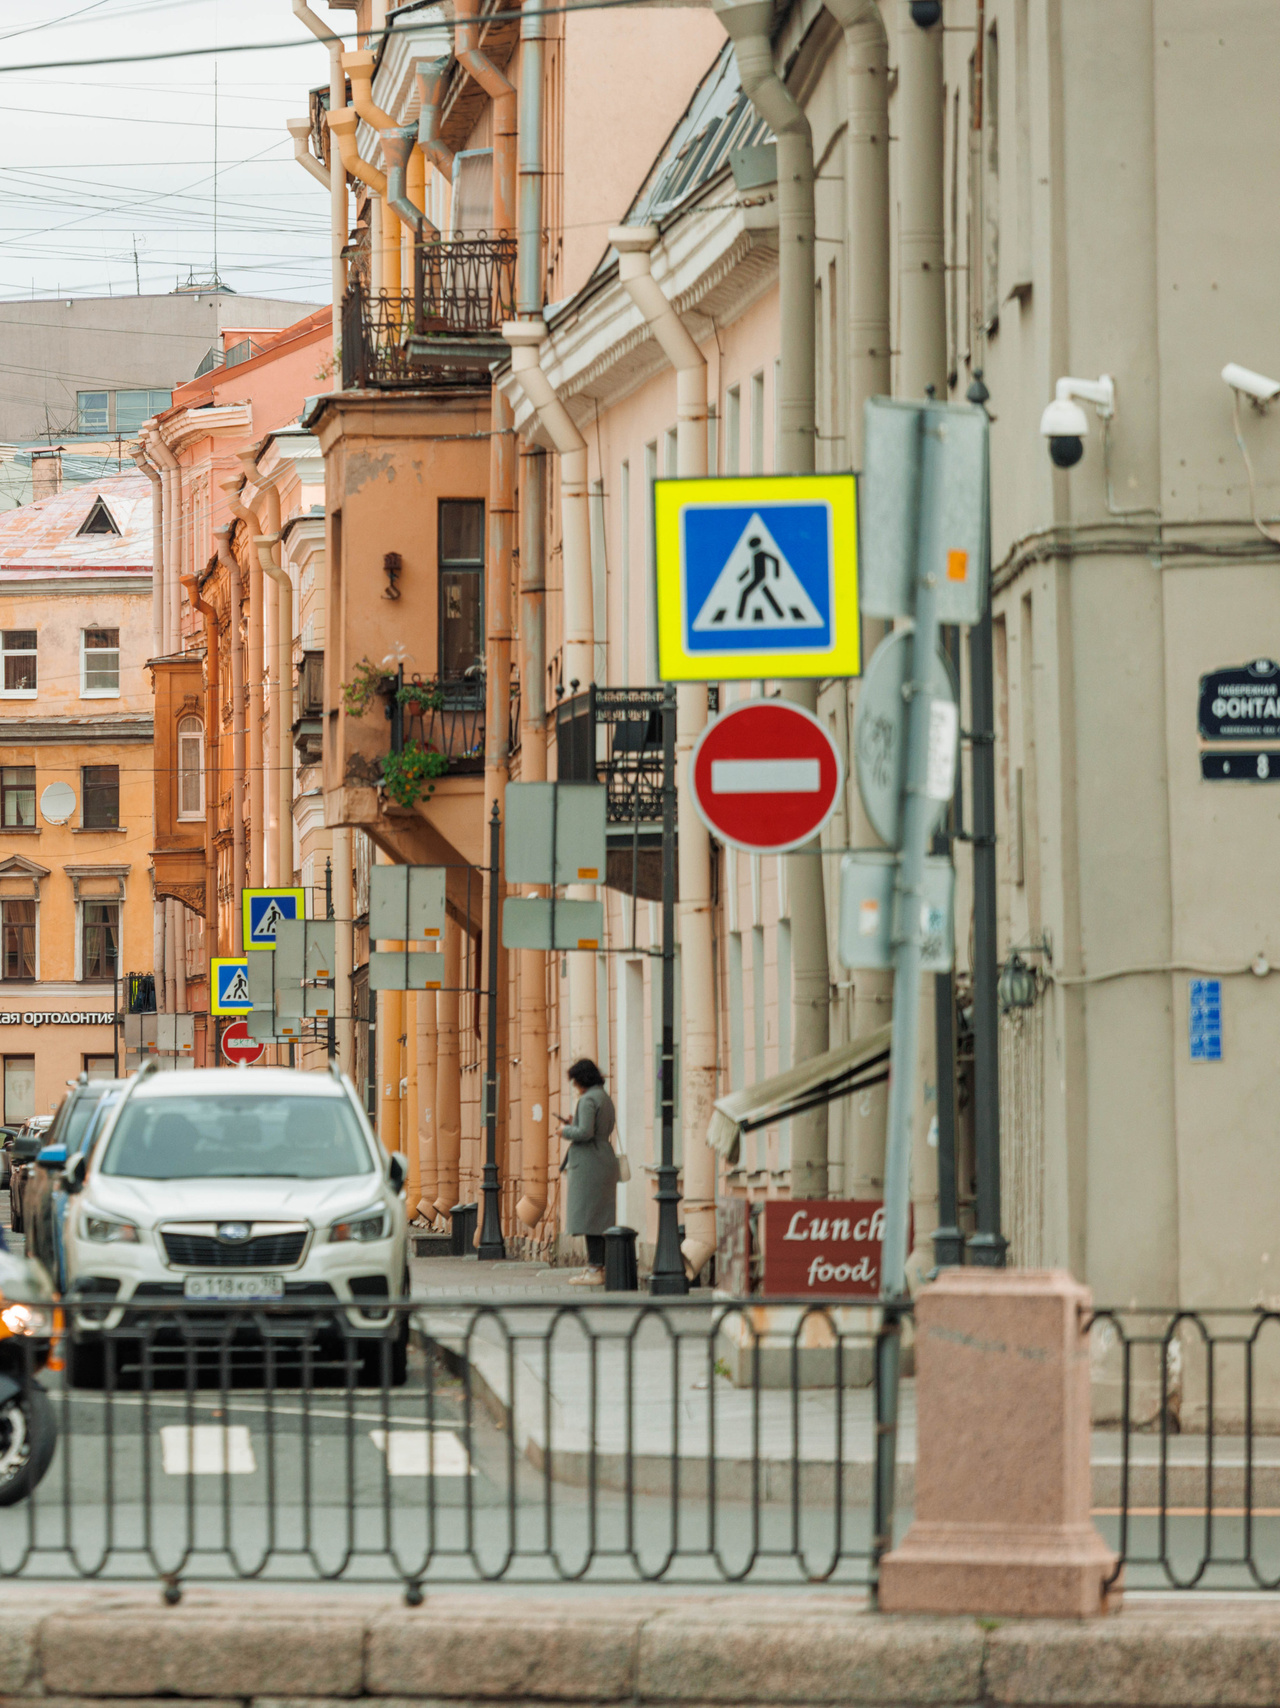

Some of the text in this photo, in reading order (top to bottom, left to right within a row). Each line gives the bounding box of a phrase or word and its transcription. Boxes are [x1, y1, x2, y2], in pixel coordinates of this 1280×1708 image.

[1211, 697, 1280, 719] ФОНТА
[23, 1012, 115, 1027] ортодонтия
[782, 1206, 887, 1242] Lunch
[807, 1255, 877, 1287] food
